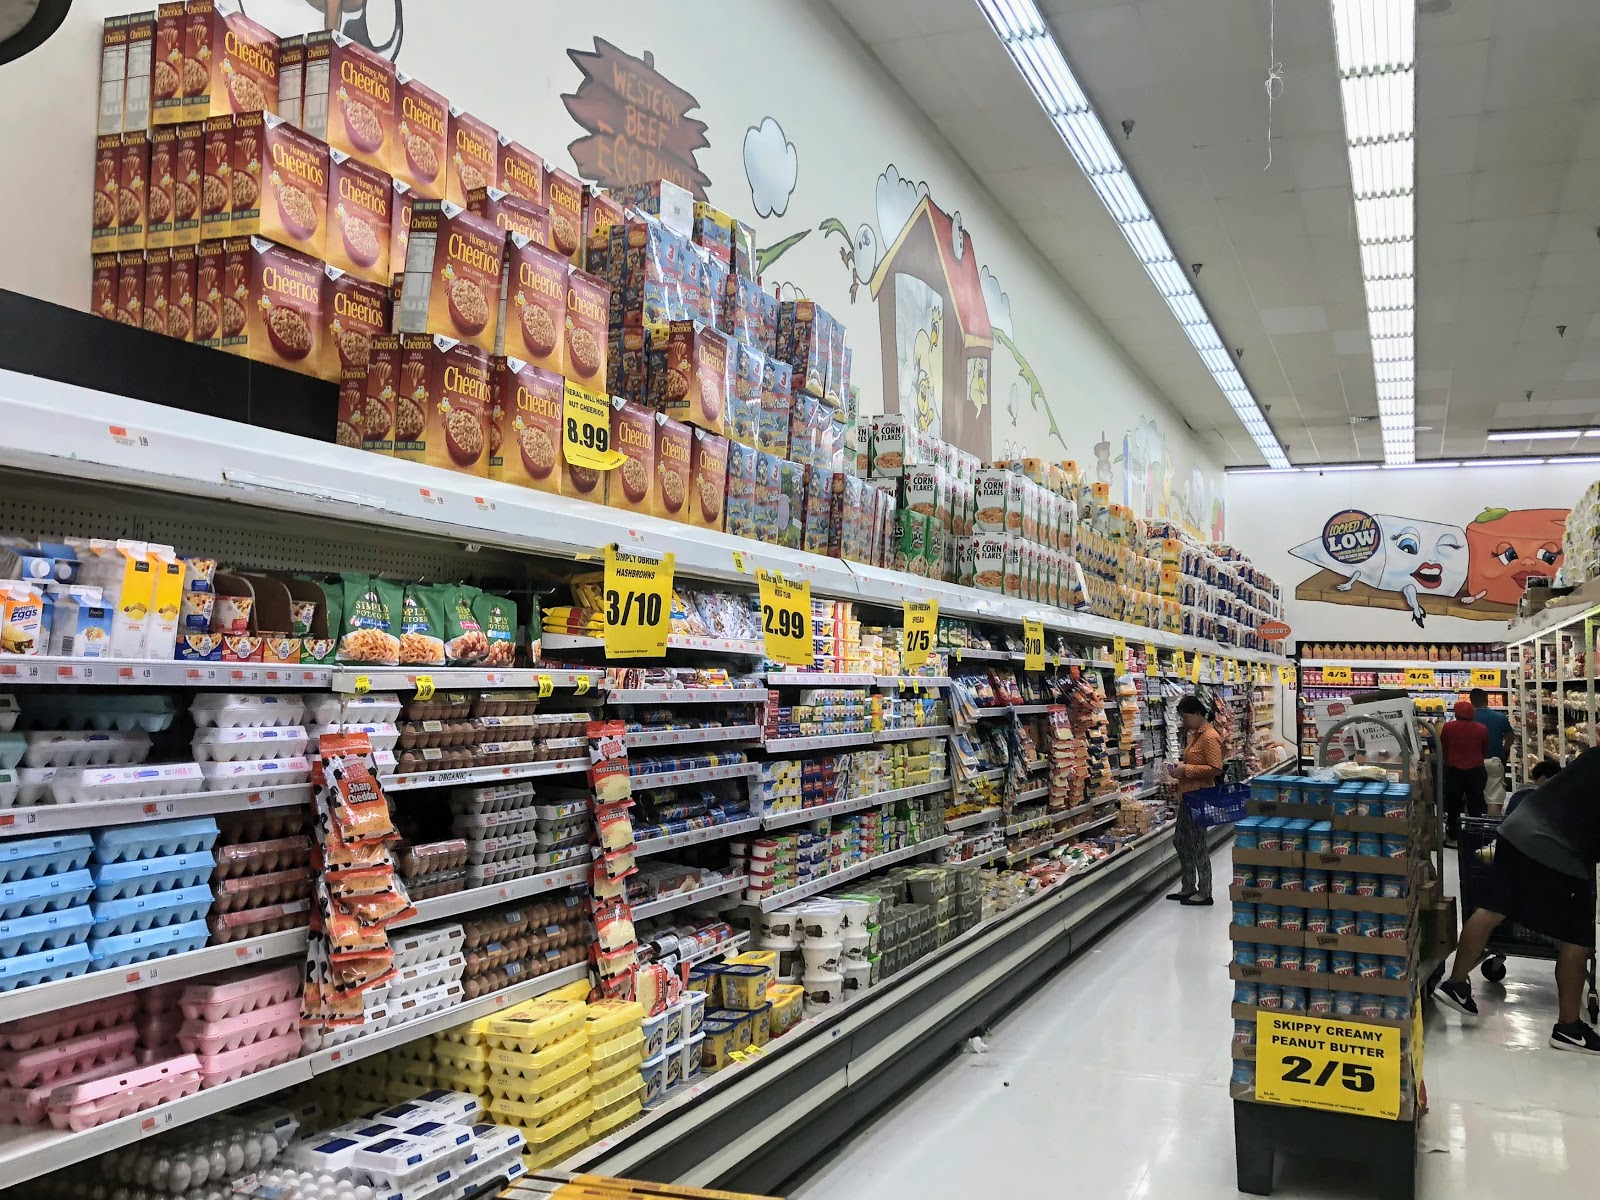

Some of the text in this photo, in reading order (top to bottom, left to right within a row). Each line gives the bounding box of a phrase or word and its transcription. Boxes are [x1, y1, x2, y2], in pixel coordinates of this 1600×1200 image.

[158, 4, 184, 17] Cheerios
[187, 2, 212, 15] Cheerios
[224, 30, 275, 79] Cheerios
[340, 60, 390, 104] Cheerios
[614, 61, 680, 128] WESTERN
[207, 118, 232, 132] Cheerios
[236, 114, 262, 128] Cheerios
[402, 96, 444, 137] Cheerios
[625, 105, 669, 150] BEEF
[97, 137, 120, 150] Cheerios
[456, 129, 494, 167] Cheerios
[597, 120, 641, 185] EGG
[272, 143, 323, 186] Cheerios
[504, 156, 540, 192] Cheerios
[338, 176, 386, 216] Cheerios
[550, 182, 581, 214] Cheerios
[411, 219, 438, 230] Cheerios
[226, 240, 249, 252] Cheerios
[469, 232, 484, 249] Honey
[172, 250, 194, 261] Cheerios
[199, 244, 222, 256] Cheerios
[448, 233, 499, 276] Cheerios
[94, 257, 116, 268] Cheerios
[262, 266, 318, 304] Cheerios
[519, 262, 563, 301] Cheerios
[334, 293, 383, 327] Cheerios
[567, 288, 606, 324] Cheerios
[371, 339, 398, 350] Cheerios
[403, 338, 432, 349] Cheerios
[699, 345, 725, 374] Cheerios
[341, 369, 367, 380] Cheerios
[444, 366, 491, 402] Cheerios
[517, 386, 561, 422] Cheerios
[584, 394, 595, 403] MILL
[569, 400, 604, 417] NUT CHEERIOS
[567, 417, 608, 452] 8.99
[618, 421, 653, 450] Cheerios
[881, 426, 900, 434] CORN
[661, 436, 690, 463] Cheerios
[700, 450, 725, 475] Cheerios
[913, 477, 933, 485] CORN
[983, 481, 1003, 489] CORN
[1329, 518, 1372, 536] LOCKED IN
[982, 544, 1002, 552] CORN
[1328, 529, 1376, 551] LOW
[615, 552, 659, 566] SIMPLY OBRIEN
[616, 568, 656, 580] HASHBROWNS
[783, 591, 791, 599] TUB
[11, 609, 37, 622] Eggs
[355, 600, 389, 613] SIMPLY
[356, 610, 391, 620] POTATOES
[606, 590, 662, 626] 3/10
[763, 604, 804, 639] 2.99
[1260, 627, 1288, 635] YOGURT
[907, 630, 930, 652] 2/5
[1025, 637, 1041, 656] 3/10
[438, 772, 467, 782] ORGANIC
[596, 765, 628, 773] MOZZARELL
[348, 782, 372, 793] Sharp
[347, 792, 378, 805] Cheddar
[1273, 1019, 1383, 1042] SKIPPY CREAMY
[1272, 1035, 1385, 1058] PEANUT BUTTER
[1281, 1055, 1375, 1093] 2/5
